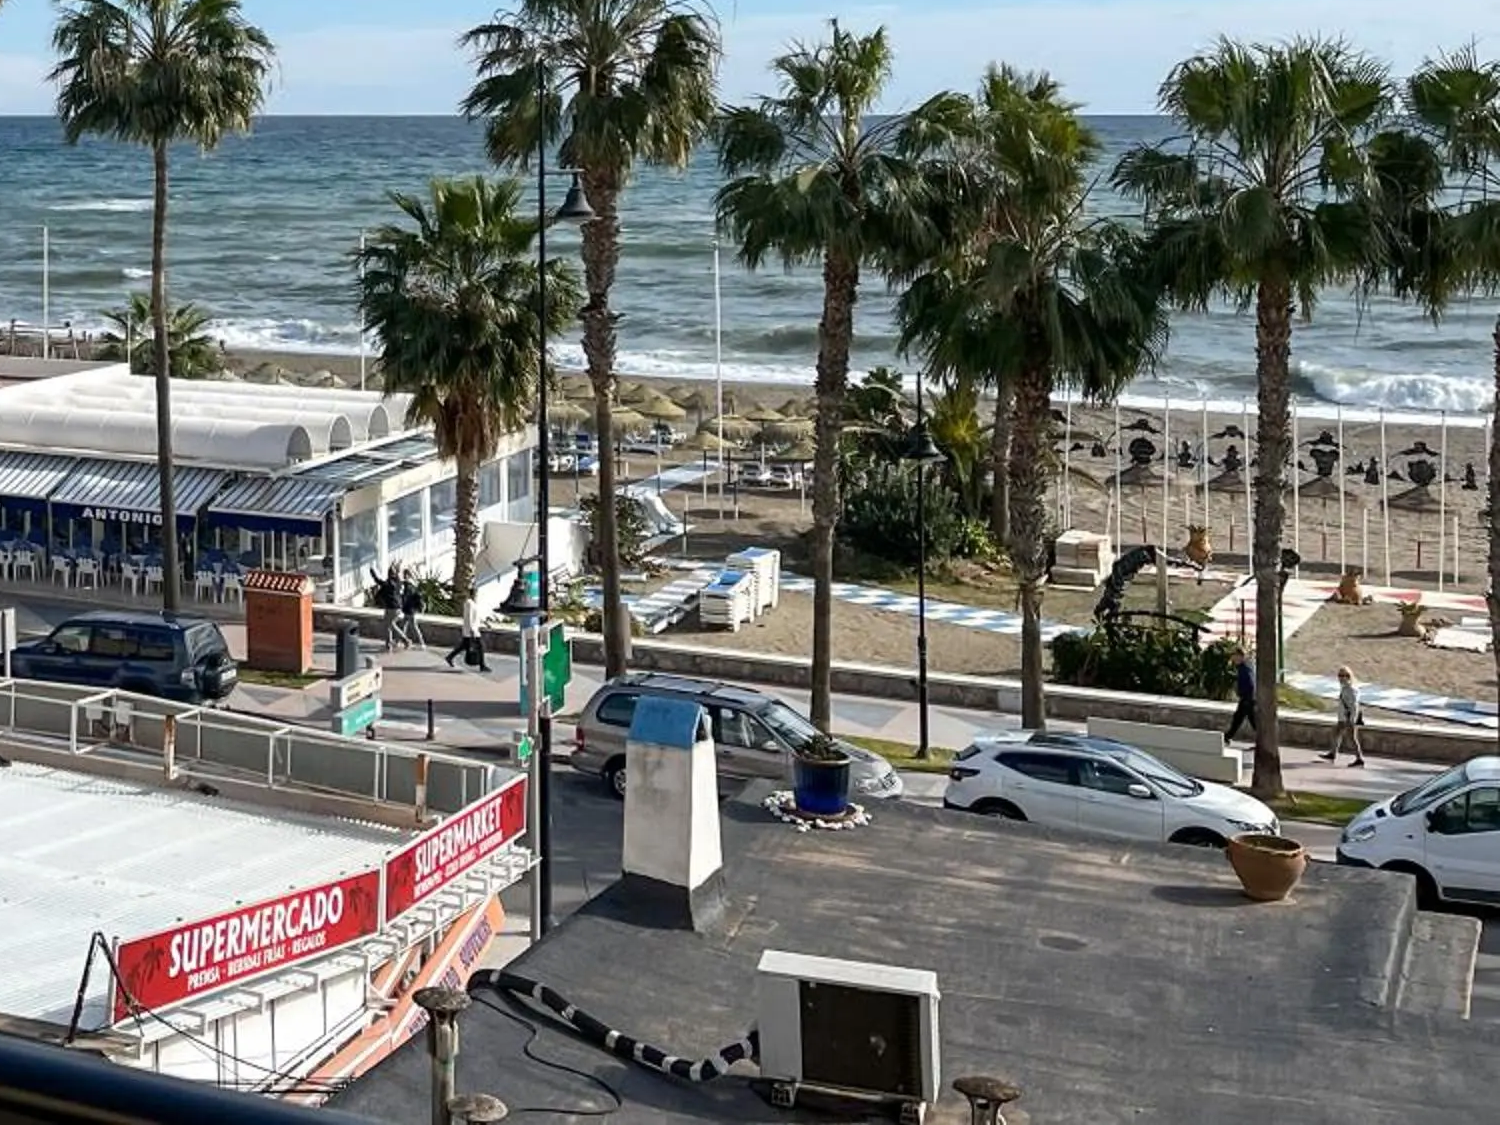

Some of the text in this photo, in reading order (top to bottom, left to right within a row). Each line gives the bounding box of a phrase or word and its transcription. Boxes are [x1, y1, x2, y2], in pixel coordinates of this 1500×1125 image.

[81, 507, 164, 525] ANTONIO
[414, 796, 504, 882] SUPERMARKET
[169, 886, 344, 978] SUPERMERCADO
